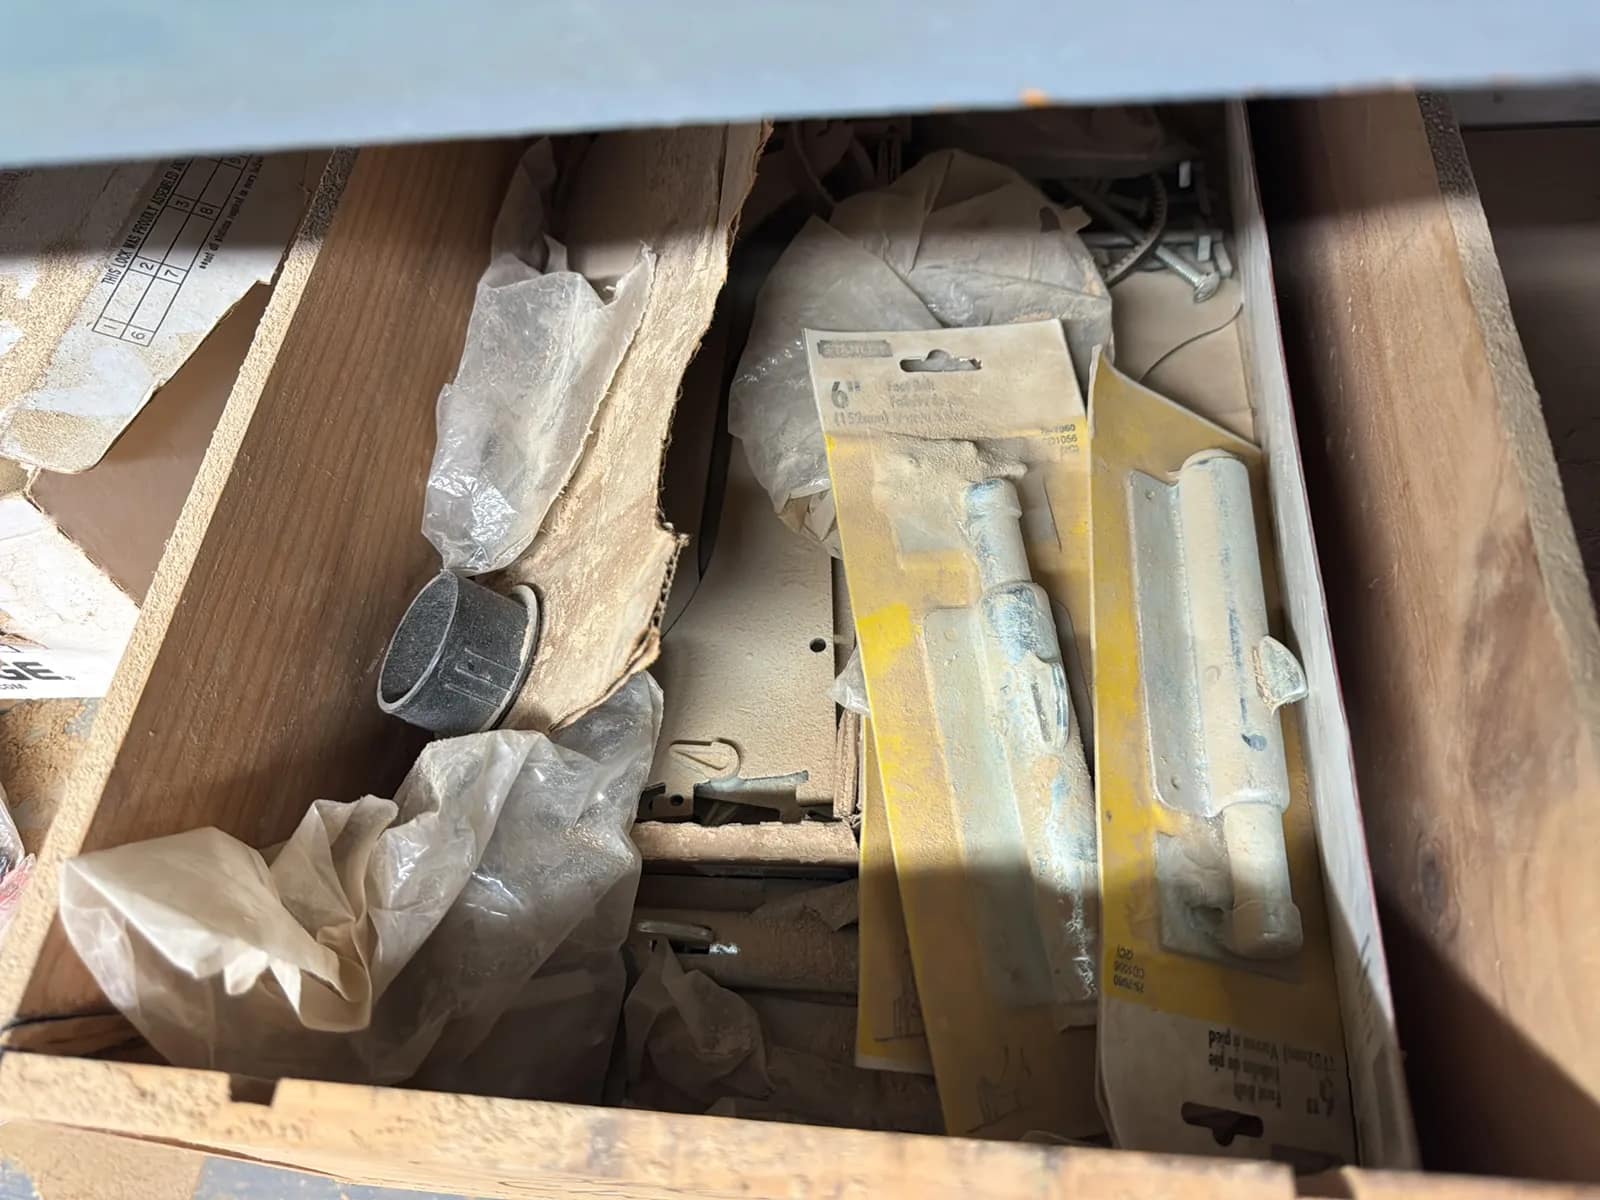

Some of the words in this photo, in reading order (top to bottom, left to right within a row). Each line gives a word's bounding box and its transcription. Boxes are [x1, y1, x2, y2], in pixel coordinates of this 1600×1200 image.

[176, 200, 190, 208] 3
[200, 206, 214, 215] 8
[111, 249, 134, 268] LOCK
[140, 262, 154, 271] 2
[101, 267, 122, 285] THIS
[164, 269, 179, 278] 7
[131, 331, 146, 340] 6
